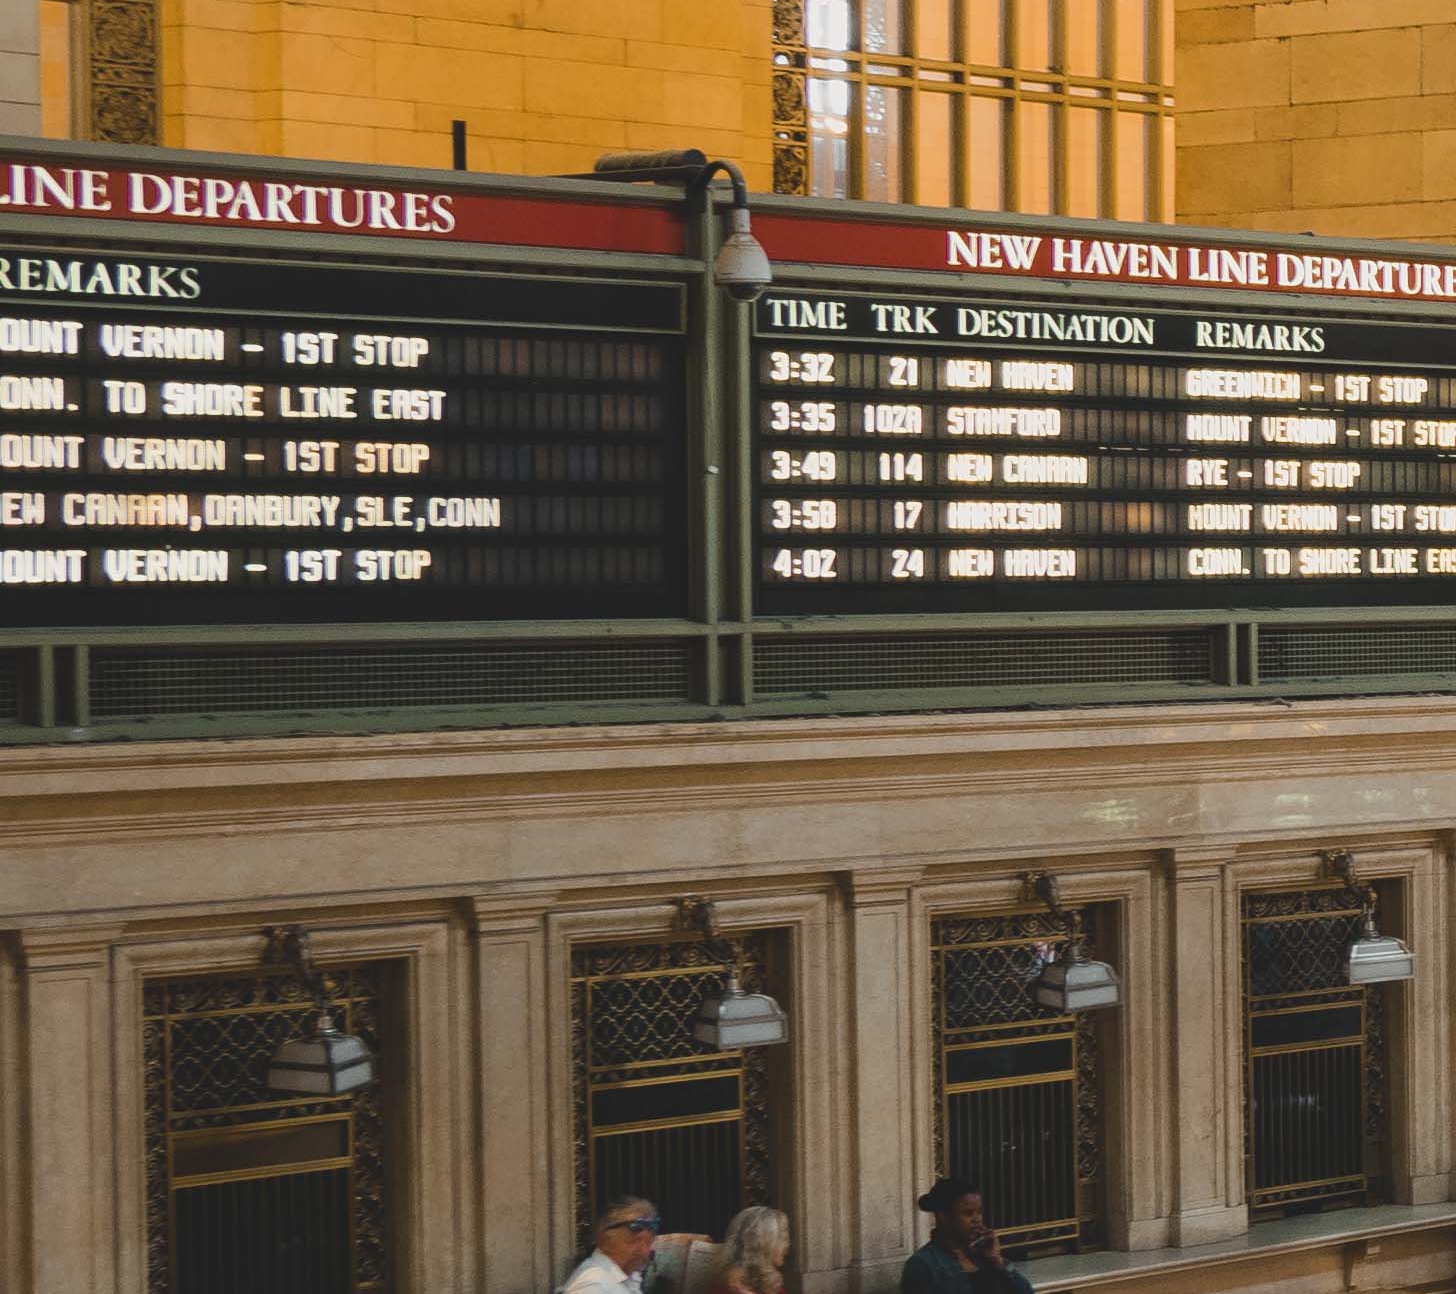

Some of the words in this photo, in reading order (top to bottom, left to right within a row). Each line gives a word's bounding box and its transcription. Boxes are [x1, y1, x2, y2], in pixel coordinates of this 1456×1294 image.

[0, 165, 111, 210] INE
[130, 173, 454, 232] DEPARTURES
[948, 231, 1042, 270] NEW
[1053, 239, 1178, 279] HAVEN
[1188, 248, 1268, 284] LINE
[768, 299, 847, 329] TIME
[871, 304, 938, 333] TRK
[958, 307, 1156, 344] DESTINATION
[1197, 322, 1324, 352] REMARKS
[101, 325, 224, 360] VERNON
[283, 333, 338, 364] 1ST
[353, 335, 428, 367] STOP
[770, 352, 835, 382] 3:32
[889, 357, 917, 386] 21
[944, 360, 991, 388] NEW
[1001, 361, 1073, 390] HAVEN
[1185, 369, 1300, 399] GREENWICH
[1335, 375, 1371, 401] 1ST
[1378, 377, 1427, 403] STOP
[104, 381, 146, 413] TO
[162, 382, 264, 416] SHORE
[280, 387, 357, 418] LINE
[372, 389, 446, 420] EAST
[771, 402, 835, 431] 3:35
[947, 407, 1060, 436] STAMFORD
[1187, 414, 1252, 441] MOUNT
[1262, 417, 1336, 444] VERNON
[1371, 420, 1405, 445] 1ST
[104, 437, 225, 470] VERNON
[285, 441, 339, 471] 1ST
[356, 443, 429, 473] STOP
[772, 451, 835, 480] 3:49
[880, 453, 922, 481] 114
[948, 454, 992, 481] NEW
[1003, 455, 1087, 483] CANAAN
[1187, 459, 1228, 485] RYE
[1265, 460, 1301, 486] 1ST
[1308, 461, 1360, 488] STOP
[0, 493, 44, 524] EW
[894, 502, 922, 528] 17
[947, 501, 1061, 530] HARRISON
[1188, 504, 1252, 530] MOUNT
[1262, 505, 1337, 530] VERNON
[1371, 505, 1406, 530] 1ST
[0, 550, 86, 583] OUNT
[104, 550, 228, 581] VERNON
[286, 550, 342, 581] 1ST
[356, 550, 431, 580] STOP
[773, 549, 836, 577] 4:02
[892, 550, 923, 577] 24
[949, 549, 993, 576] NEW
[1004, 549, 1075, 576] HAVEN
[1188, 548, 1250, 575] CONN.
[1263, 549, 1290, 574] TO
[1298, 548, 1361, 574] SHORE
[1370, 549, 1418, 573] LINE
